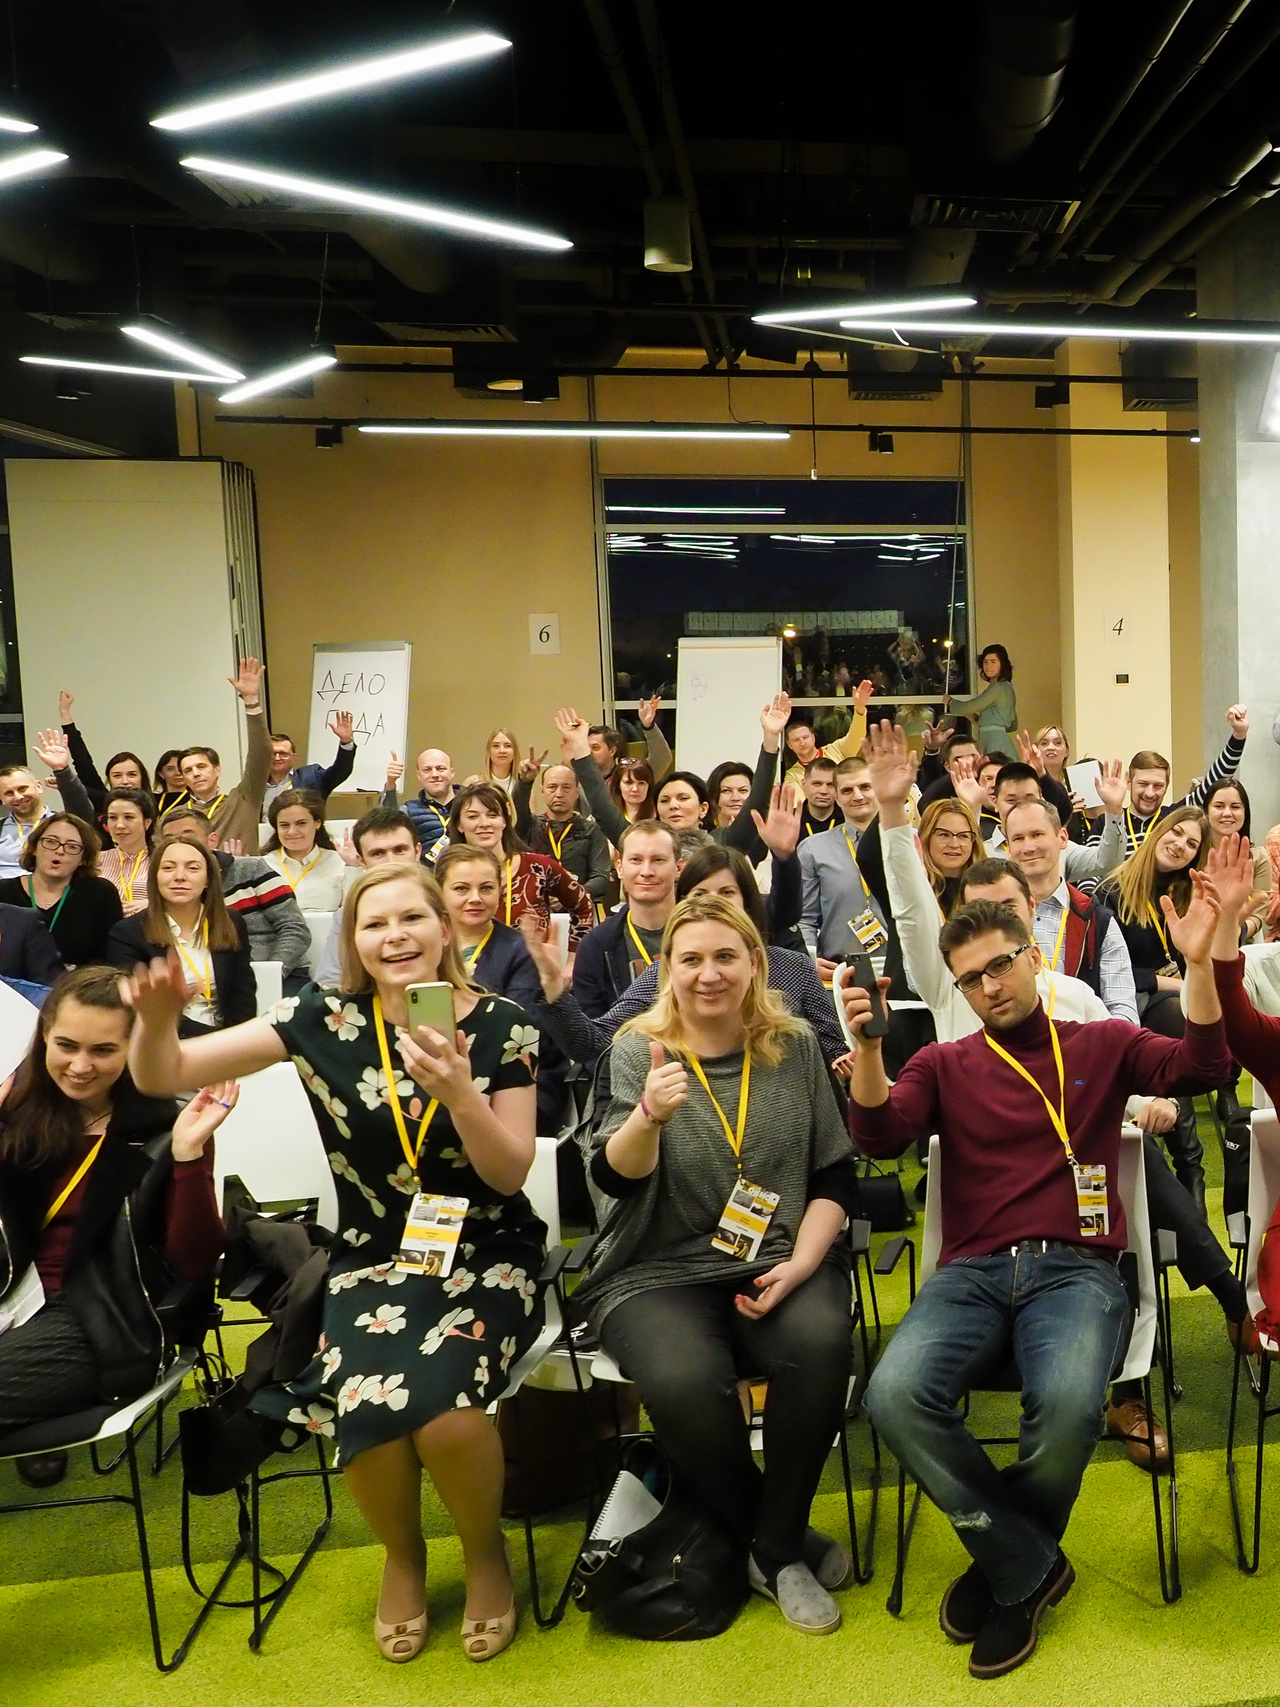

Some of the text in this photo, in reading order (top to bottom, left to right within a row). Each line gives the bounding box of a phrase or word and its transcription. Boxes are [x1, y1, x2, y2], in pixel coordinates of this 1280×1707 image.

[538, 624, 552, 643] 6
[1112, 617, 1124, 636] 4
[316, 669, 387, 704] ДЕЛО
[324, 708, 386, 746] ГДА
